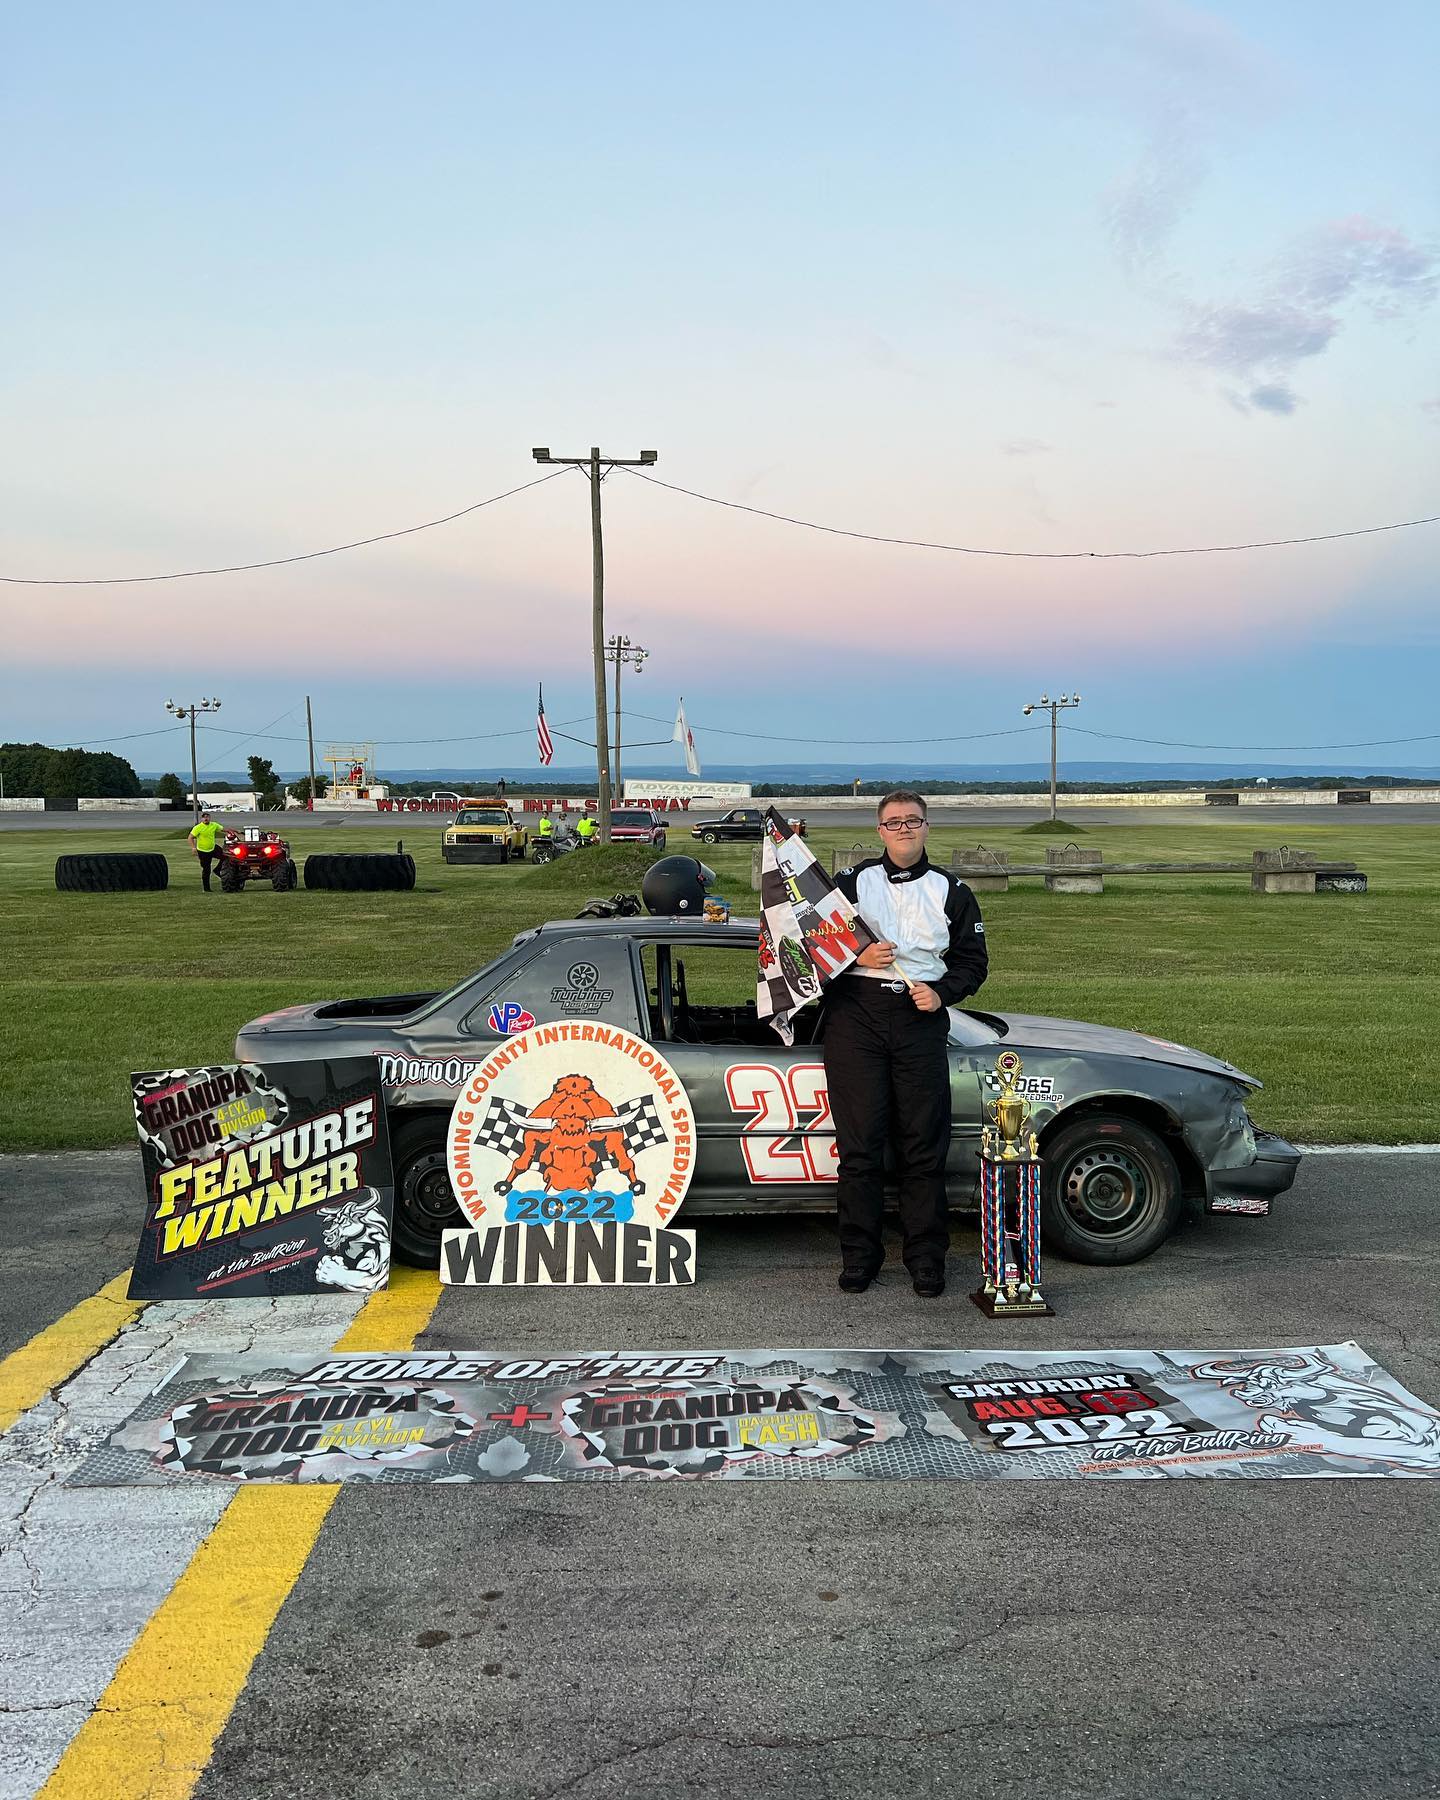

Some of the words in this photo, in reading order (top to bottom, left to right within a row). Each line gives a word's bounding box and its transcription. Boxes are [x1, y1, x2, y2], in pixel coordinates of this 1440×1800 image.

[631, 782, 743, 793] ADVANTAGE
[584, 799, 692, 812] SEEDWAY
[551, 986, 613, 1001] Turbine
[490, 1002, 522, 1034] VP
[466, 1036, 529, 1105] COUNTY
[535, 1025, 681, 1104] INTERNATIONAL
[144, 1069, 252, 1130] GRANDPA
[217, 1098, 249, 1121] 4-CYL
[1016, 1093, 1063, 1101] PEEDSHOP
[170, 1113, 223, 1156] DOG
[220, 1107, 267, 1137] DIVISION
[724, 1063, 840, 1184] 22
[155, 1098, 375, 1220] FEATURE
[453, 1111, 487, 1221] WYOMING
[654, 1108, 691, 1221] SPEEDWAY
[162, 1151, 360, 1255] WINNER
[516, 1197, 616, 1219] 2022
[207, 1264, 225, 1281] at
[227, 1257, 251, 1274] the
[250, 1239, 306, 1267] BullRing
[444, 1222, 692, 1285] WINNER
[303, 1359, 489, 1381] HOME
[494, 1358, 576, 1379] OF
[591, 1357, 717, 1378] THE
[949, 1374, 1132, 1399] SATURDAY
[190, 1392, 419, 1433] GRANDPA
[591, 1388, 809, 1428] GRANDPA
[973, 1397, 1081, 1420] AUG.
[1090, 1391, 1151, 1414] 13
[318, 1427, 425, 1447] DIVISION
[327, 1415, 394, 1434] 4-CYL
[622, 1421, 728, 1456] DOG
[740, 1421, 819, 1444] CASH
[987, 1410, 1189, 1448] 2022
[204, 1424, 322, 1460] DOG
[1081, 1462, 1132, 1472] WYOMING
[1135, 1458, 1178, 1466] COUNTY
[1180, 1451, 1266, 1462] INTERNATIONAL
[1266, 1444, 1323, 1454] SPEEDWAY
[1094, 1444, 1127, 1459] at
[1132, 1439, 1178, 1458] the
[1178, 1430, 1285, 1452] BullRing
